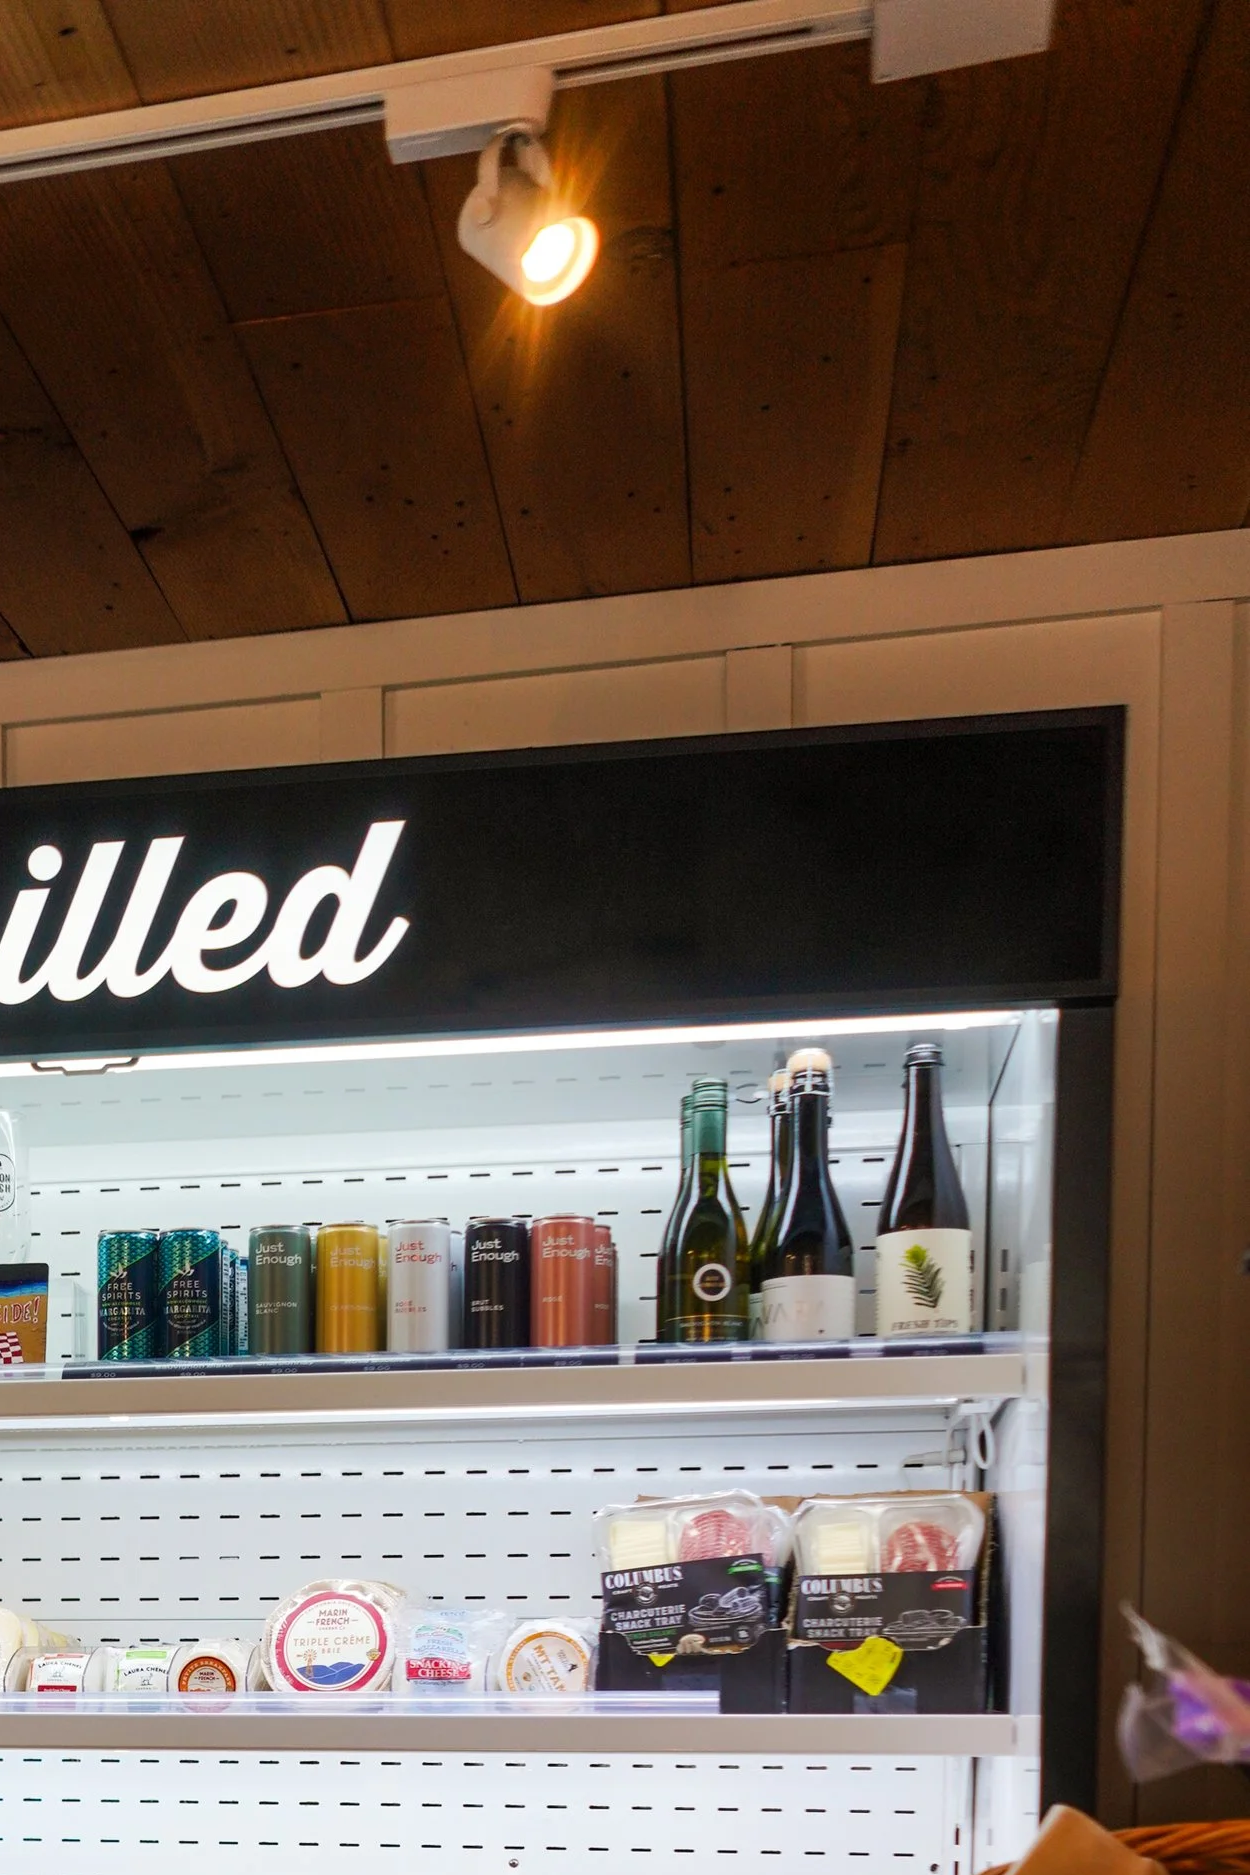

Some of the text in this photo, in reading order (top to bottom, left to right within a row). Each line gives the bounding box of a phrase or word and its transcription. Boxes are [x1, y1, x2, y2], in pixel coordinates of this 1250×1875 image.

[395, 1240, 425, 1252] Just
[471, 1238, 501, 1251] Just
[542, 1235, 574, 1247] Just
[256, 1242, 284, 1254] Just
[330, 1246, 361, 1257] Just
[543, 1247, 590, 1259] Enough
[256, 1254, 302, 1267] Enough
[395, 1252, 442, 1264] Enough
[471, 1251, 520, 1263] Enough
[330, 1257, 375, 1269] Enough
[107, 1282, 133, 1291] FREE
[173, 1280, 200, 1289] FREE
[102, 1291, 141, 1301] SPIRITS
[167, 1290, 207, 1298] SPIRITS
[99, 1307, 145, 1316] MARGARITA
[165, 1305, 211, 1314] MARGARITA
[256, 1307, 279, 1315] BLANC
[318, 1609, 347, 1617] MARIN
[610, 1604, 686, 1621] CHARCUTERIE
[315, 1617, 350, 1626] FRENCH
[615, 1615, 683, 1631] SNACK TRAY
[803, 1617, 883, 1628] CHARCUTERIE
[806, 1628, 877, 1638] SNACK TRAY
[293, 1638, 329, 1647] TRIPLE
[409, 1658, 468, 1671] SNACKING
[123, 1667, 144, 1677] LAURA
[417, 1668, 460, 1678] CHEESE
